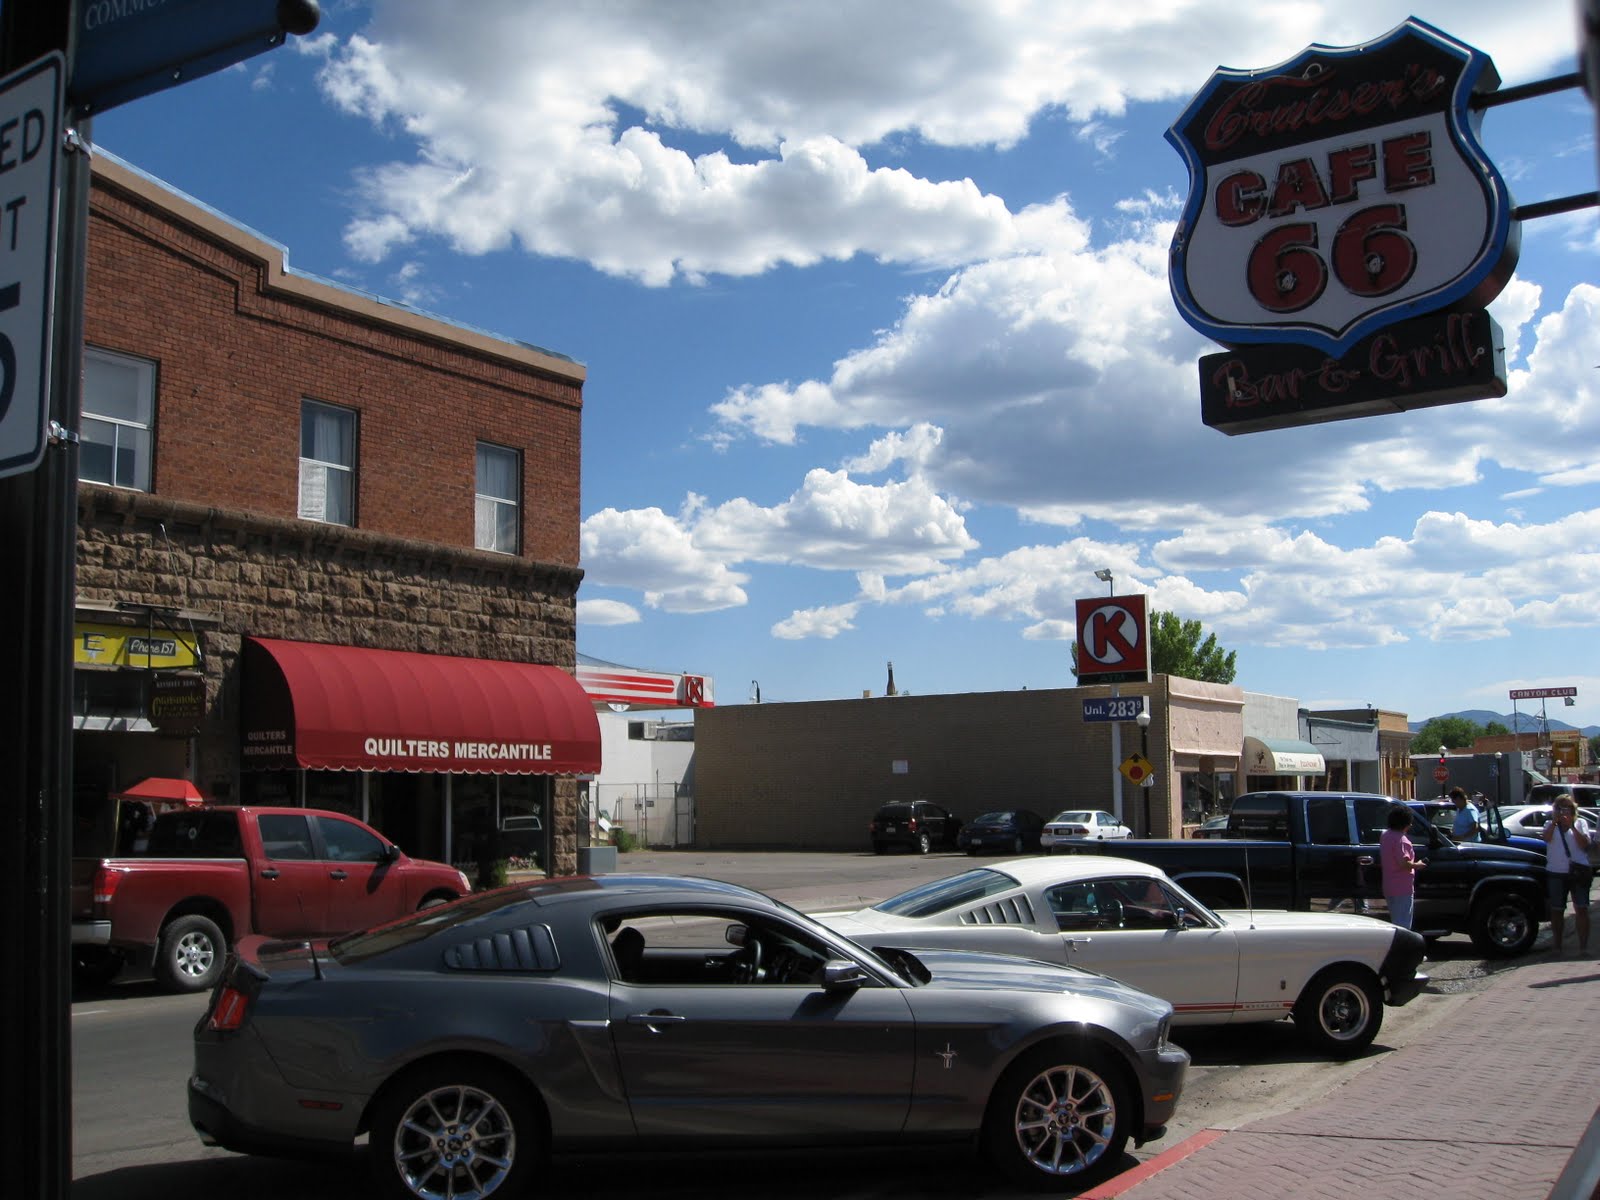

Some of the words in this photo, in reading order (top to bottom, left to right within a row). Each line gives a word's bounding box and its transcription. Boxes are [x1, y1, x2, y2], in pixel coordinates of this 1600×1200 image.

[1205, 63, 1445, 151] Cruiser's
[1216, 131, 1436, 228] CAFE
[1246, 203, 1418, 314] 66
[1213, 358, 1305, 408] Bar
[1370, 311, 1480, 387] Grill
[130, 638, 160, 654] Phone
[160, 642, 175, 655] 157
[1511, 690, 1547, 698] CANYON
[1551, 688, 1575, 696] CLUB
[1084, 705, 1106, 716] Unl.
[247, 730, 287, 742] QUILTERS
[243, 745, 293, 756] MERCANTILE
[364, 737, 450, 759] QUILTERS
[454, 742, 552, 761] MERCANTILE
[1434, 770, 1448, 778] STOP
